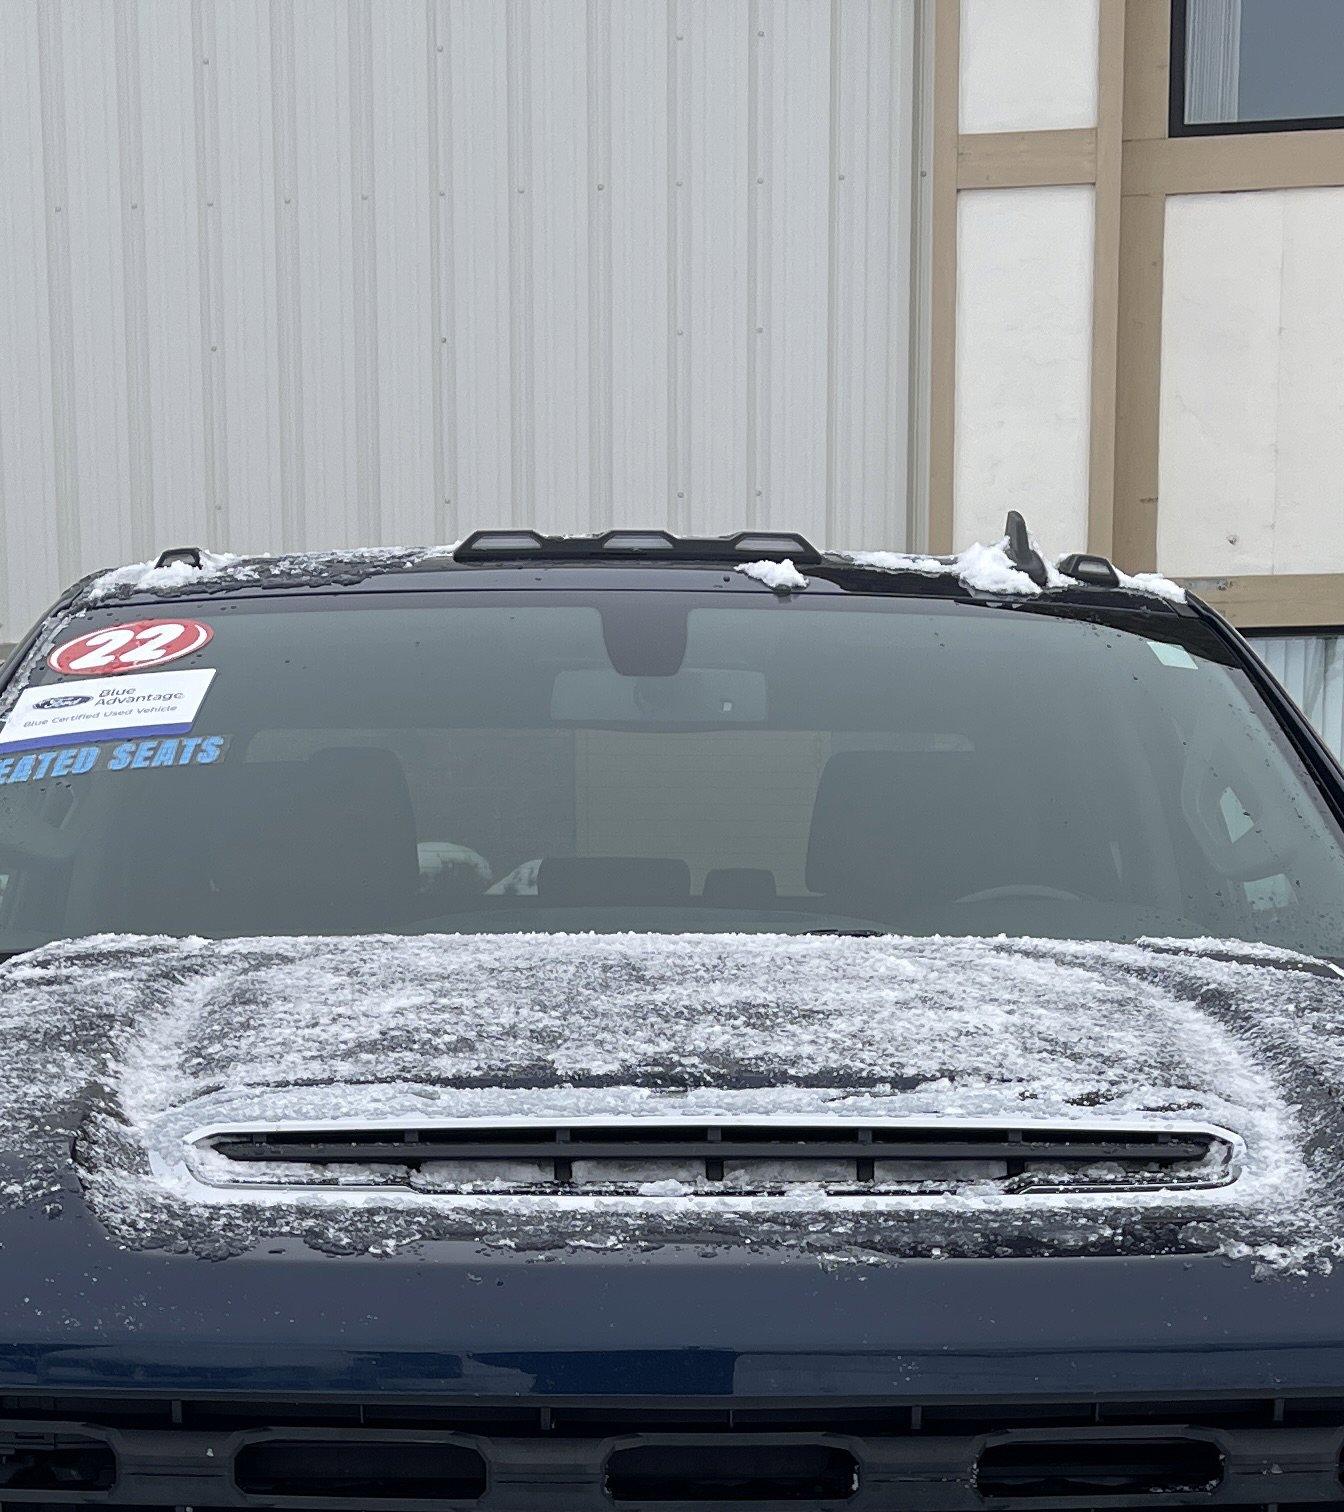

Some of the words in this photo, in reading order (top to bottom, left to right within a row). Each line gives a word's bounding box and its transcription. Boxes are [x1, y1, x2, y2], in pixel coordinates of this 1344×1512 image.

[67, 623, 185, 670] 22
[94, 692, 184, 707] Advantage
[98, 687, 137, 698] Blue
[23, 719, 48, 728] Blue
[51, 711, 100, 724] Certified
[104, 708, 133, 718] Used
[137, 705, 178, 716] Vehicle
[108, 735, 225, 771] SEATS
